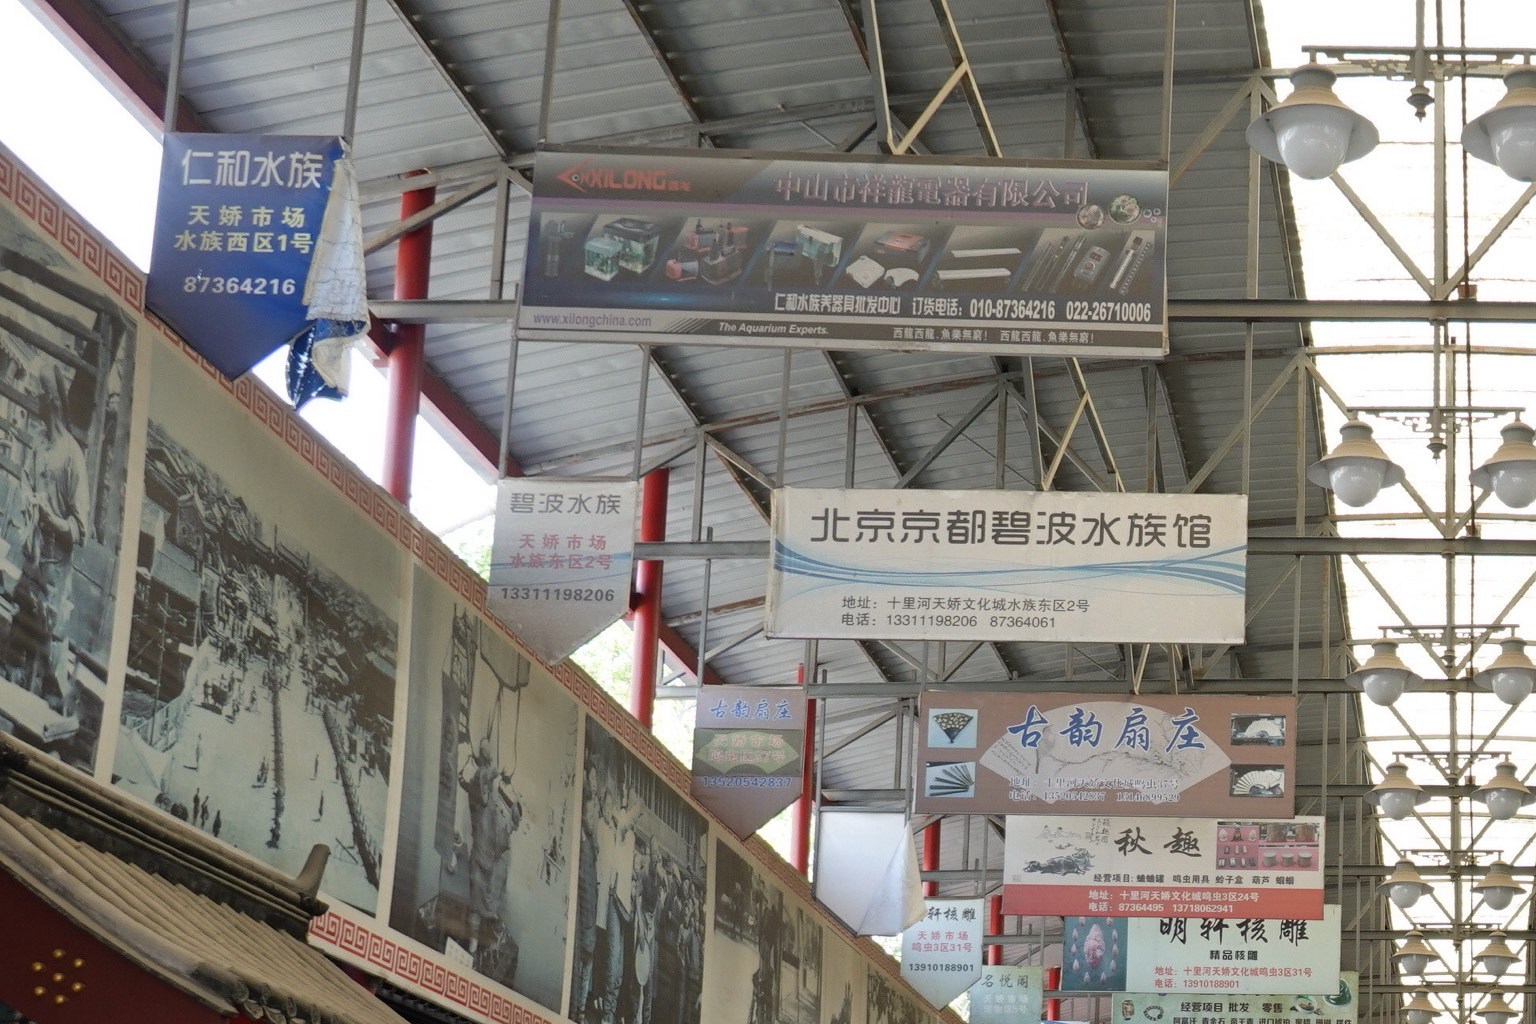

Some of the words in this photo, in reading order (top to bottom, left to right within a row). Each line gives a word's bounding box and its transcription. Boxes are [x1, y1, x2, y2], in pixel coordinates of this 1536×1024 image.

[182, 149, 323, 189] 仁和水族
[187, 205, 305, 228] 天娇市场
[174, 230, 314, 253] 水族西区1号
[184, 276, 296, 295] 87364216
[1065, 301, 1151, 322] 022-26710006
[533, 312, 652, 328] www.xilongchina.com
[718, 322, 736, 333] The
[737, 322, 787, 335] Aquarium
[789, 324, 830, 336] Experts.
[510, 492, 622, 515] 碧波水族
[811, 507, 1212, 549] 北京京都碧波水族馆
[519, 534, 607, 551] 天娇市场
[509, 553, 613, 570] 水族东区2号
[501, 587, 615, 602] 13311198206
[990, 615, 1056, 629] 87364061
[1007, 704, 1206, 754] 古韵扇庄
[703, 776, 793, 788] 13520542837
[1114, 826, 1203, 857] 秋趣
[1172, 874, 1211, 886] 鸣虫用具
[921, 906, 977, 923] 轩核雕
[1172, 903, 1234, 914] 13718062941
[917, 930, 968, 940] 天娇市场
[912, 942, 973, 953] 鸣虫3区31号
[1210, 950, 1258, 961] 精品核雕
[909, 963, 974, 972] 13910188901
[1180, 1002, 1223, 1013] 经营项目
[1228, 1002, 1250, 1012] 批发
[1262, 1003, 1283, 1013] 零售
